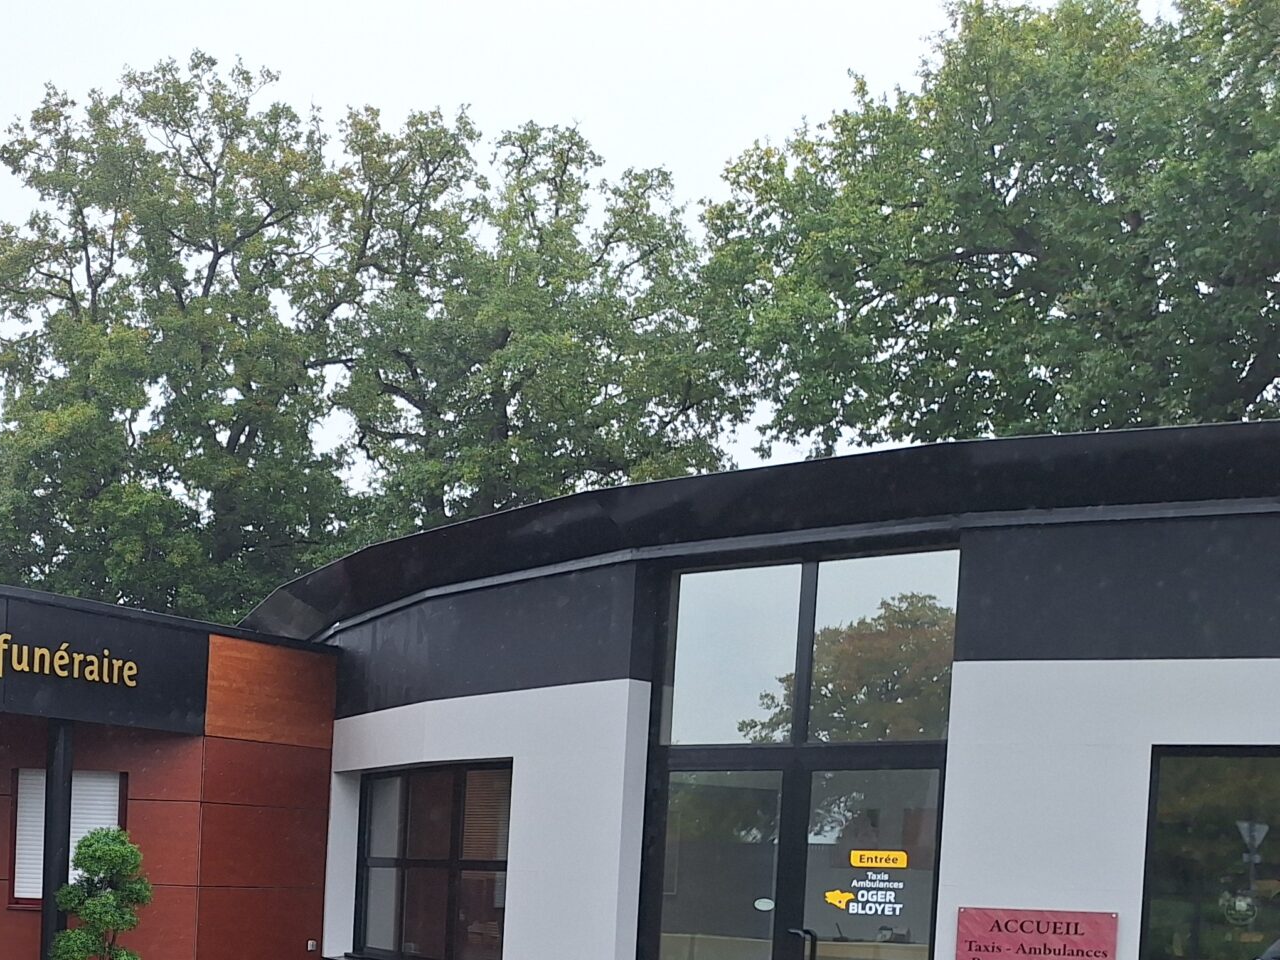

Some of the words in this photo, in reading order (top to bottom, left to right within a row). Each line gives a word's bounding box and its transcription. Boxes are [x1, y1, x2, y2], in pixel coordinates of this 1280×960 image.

[858, 854, 899, 864] Entrée
[866, 871, 889, 881] Taxis
[851, 879, 904, 889] Ambulances
[857, 889, 896, 902] OGER
[848, 902, 903, 916] BLOYET
[989, 919, 1085, 936] ACCUEIL
[964, 940, 1002, 954] Taxis
[1015, 943, 1108, 958] Ambulances
